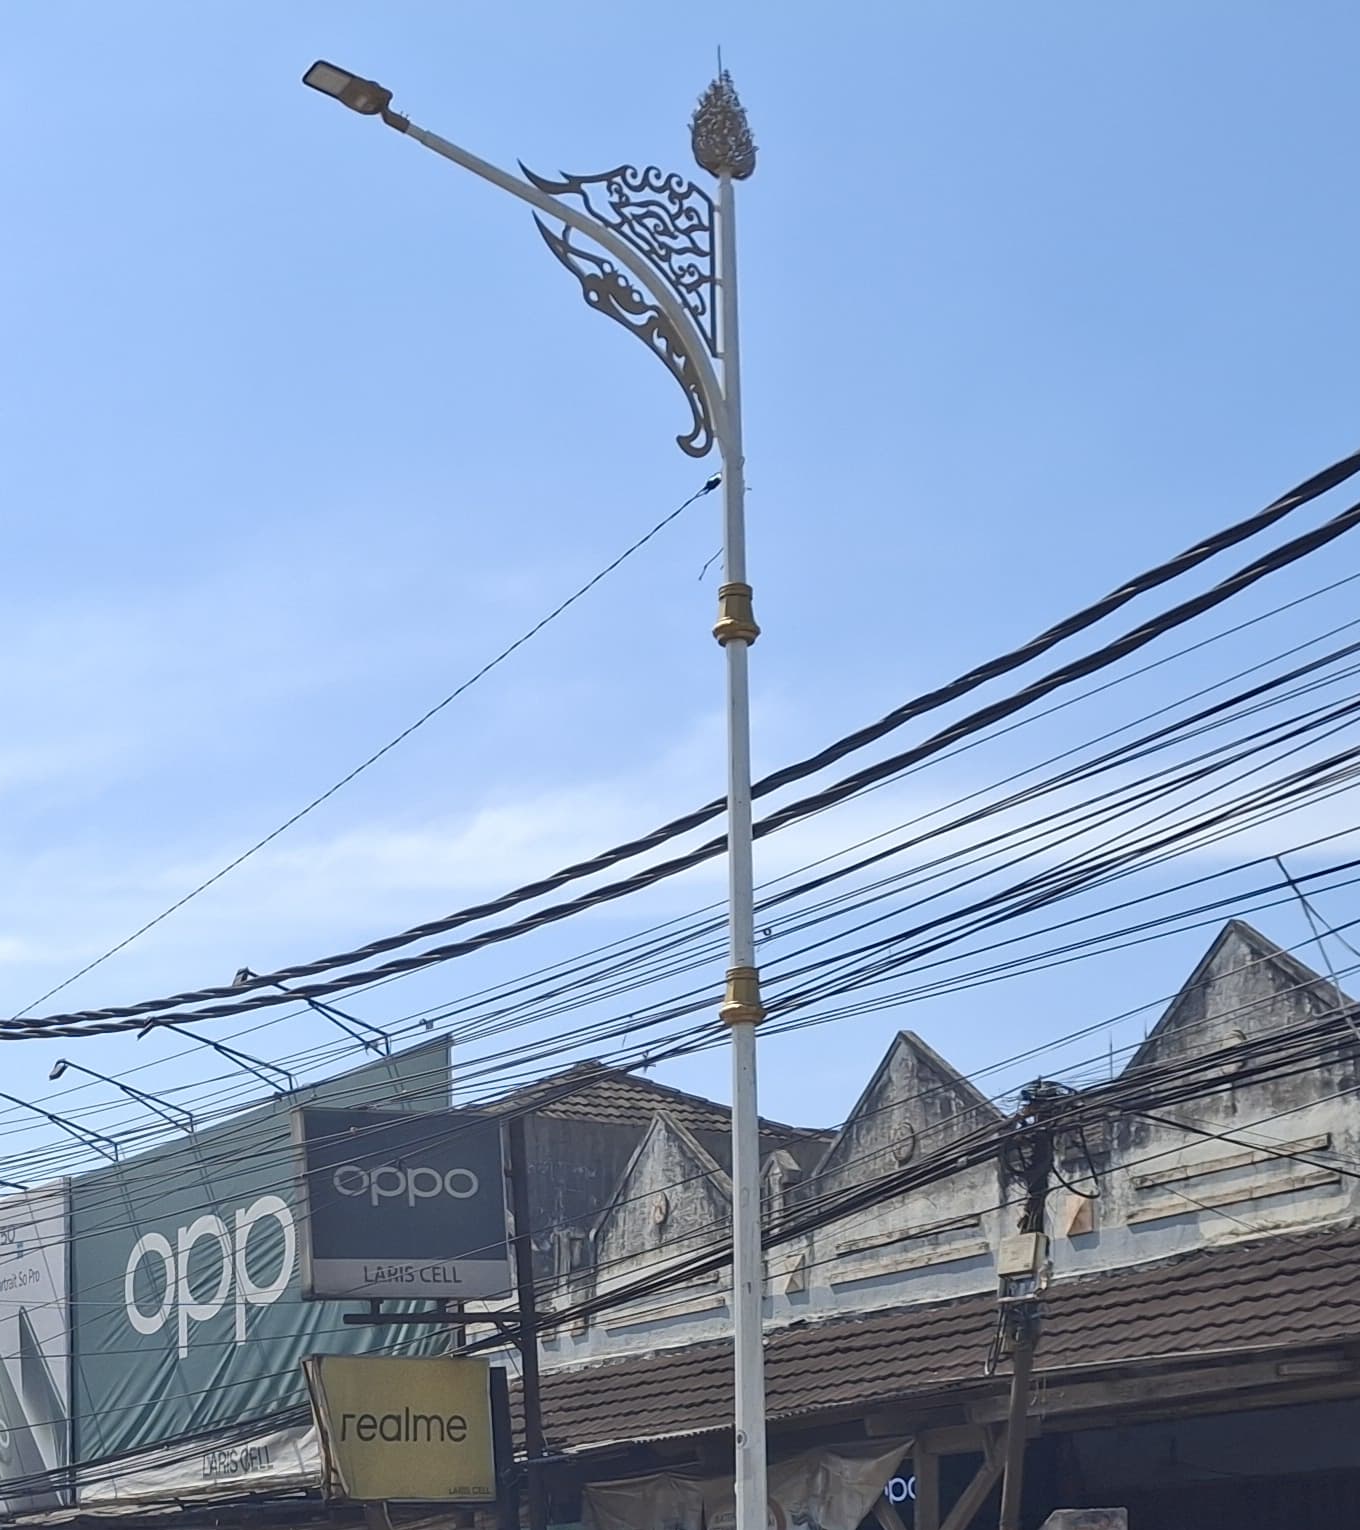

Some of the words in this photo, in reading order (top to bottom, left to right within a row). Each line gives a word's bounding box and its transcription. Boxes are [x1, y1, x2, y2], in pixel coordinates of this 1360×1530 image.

[333, 1165, 479, 1208] oppo
[28, 1268, 41, 1285] Pro
[124, 1195, 297, 1360] opp
[364, 1265, 416, 1284] LARIS
[419, 1266, 463, 1284] CELL
[341, 1406, 468, 1443] realme
[240, 1445, 274, 1474] CELL
